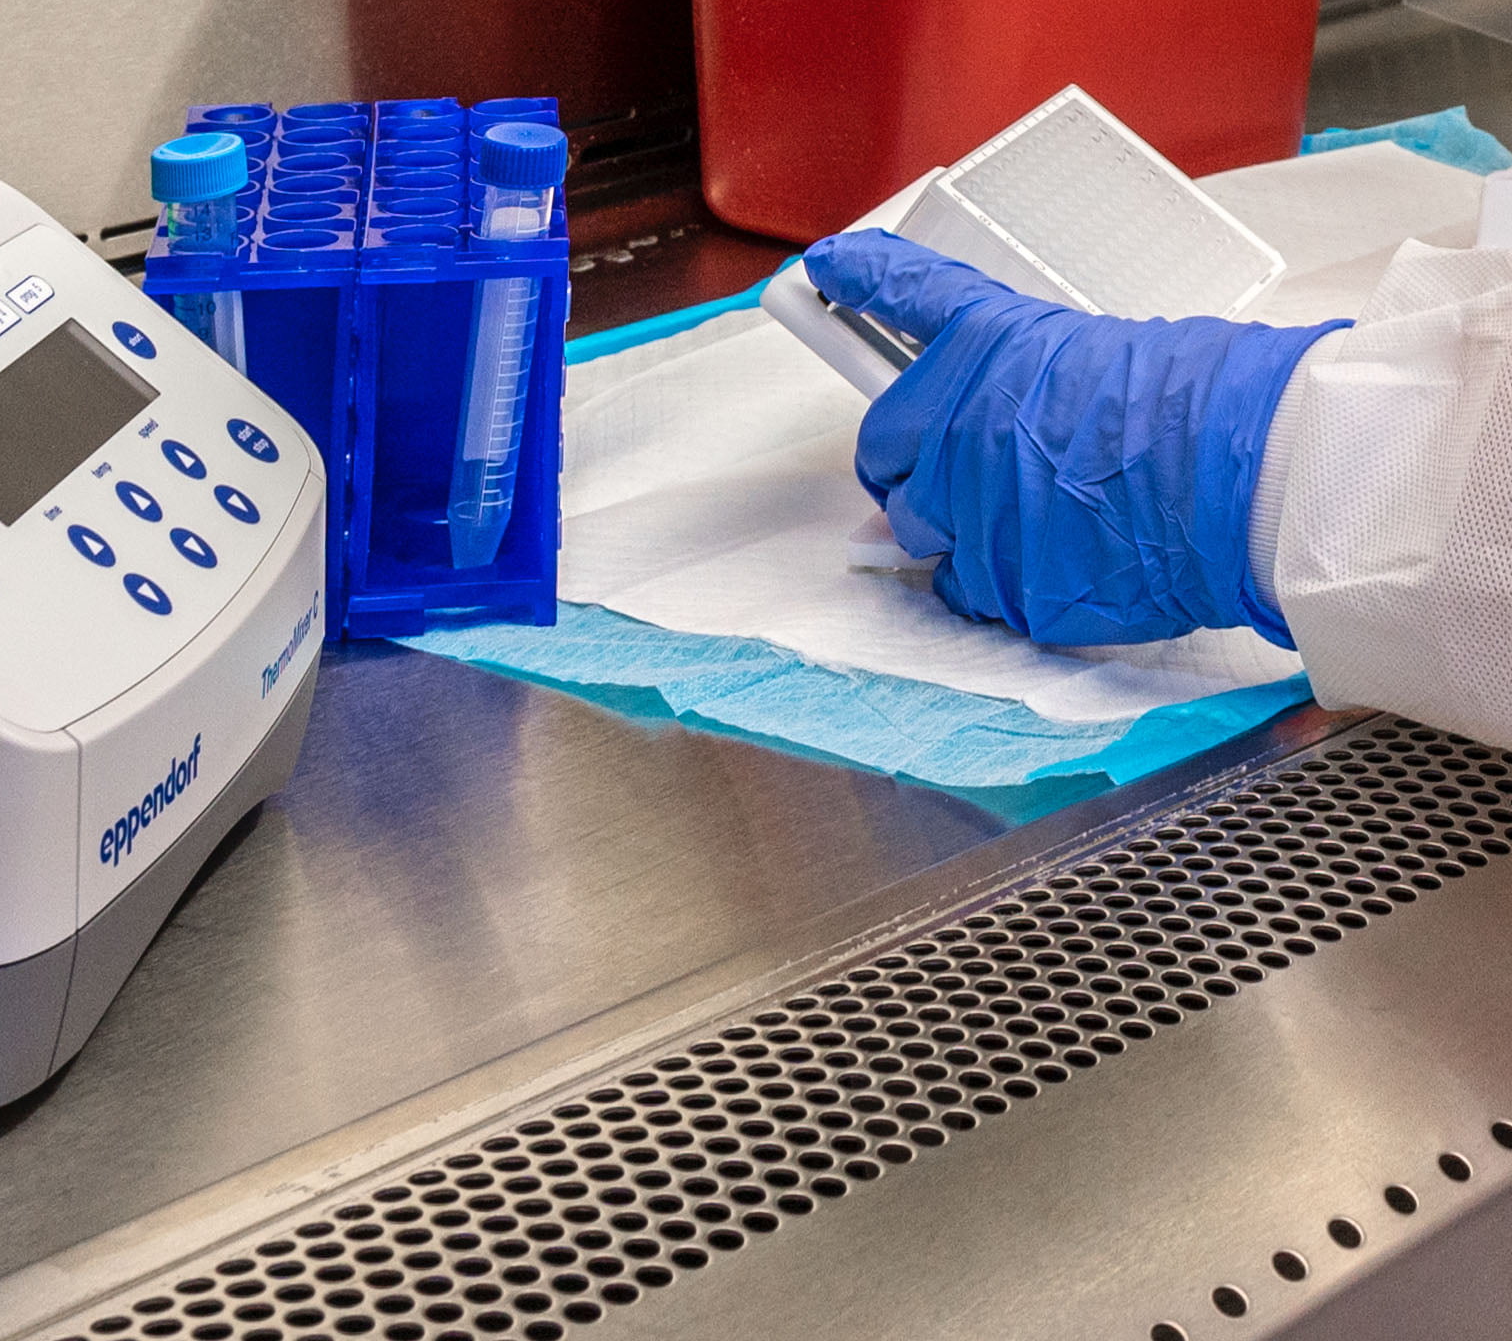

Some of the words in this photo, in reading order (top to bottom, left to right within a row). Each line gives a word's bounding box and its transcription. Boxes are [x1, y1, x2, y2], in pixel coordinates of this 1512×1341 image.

[195, 226, 213, 242] 13
[138, 418, 159, 439] speed
[261, 608, 313, 700] ThermoMixer
[312, 590, 320, 619] C
[99, 732, 202, 867] eppendorf
